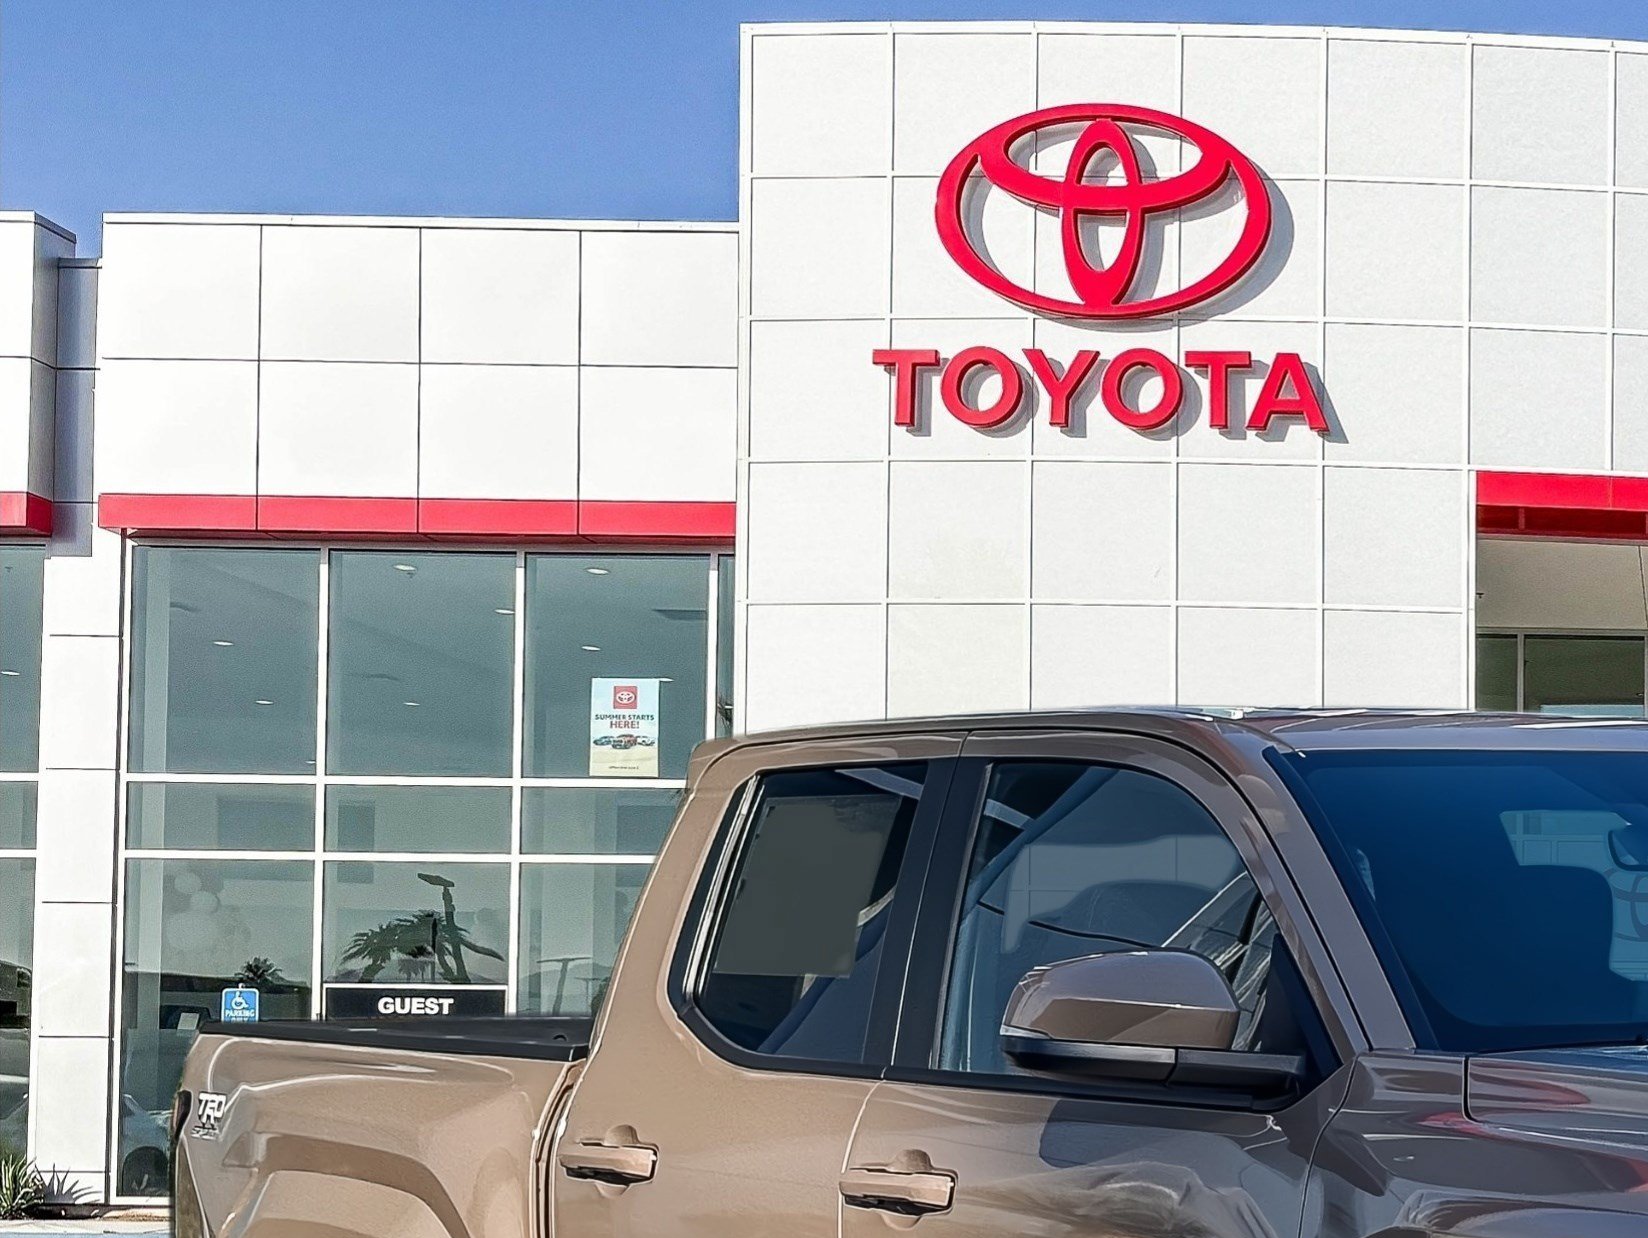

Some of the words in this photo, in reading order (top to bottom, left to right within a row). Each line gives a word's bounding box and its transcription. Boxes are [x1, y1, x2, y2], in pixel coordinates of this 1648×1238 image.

[873, 346, 1329, 433] TOYOTA
[609, 720, 640, 729] HERE!
[225, 1009, 255, 1017] PARKING
[377, 997, 454, 1015] GUEST
[198, 1092, 227, 1124] TRD
